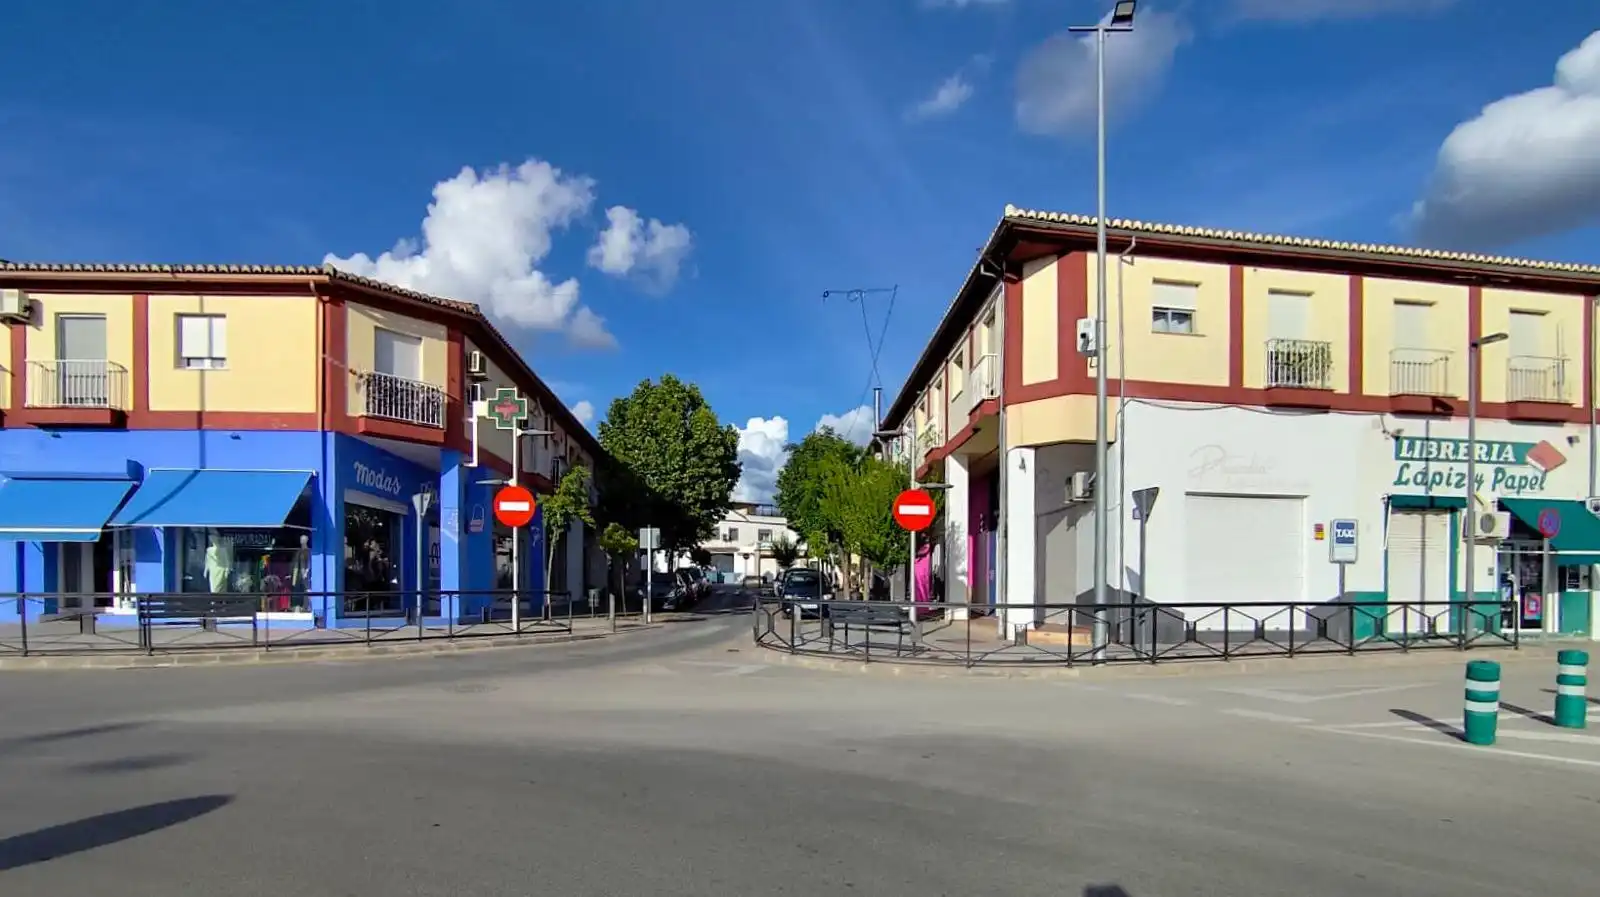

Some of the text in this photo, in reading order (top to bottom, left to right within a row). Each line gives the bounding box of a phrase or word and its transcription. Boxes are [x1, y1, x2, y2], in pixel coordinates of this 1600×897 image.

[1399, 438, 1517, 463] LIBRERIA
[1393, 462, 1466, 491] Lápiz
[1491, 466, 1547, 495] Papel
